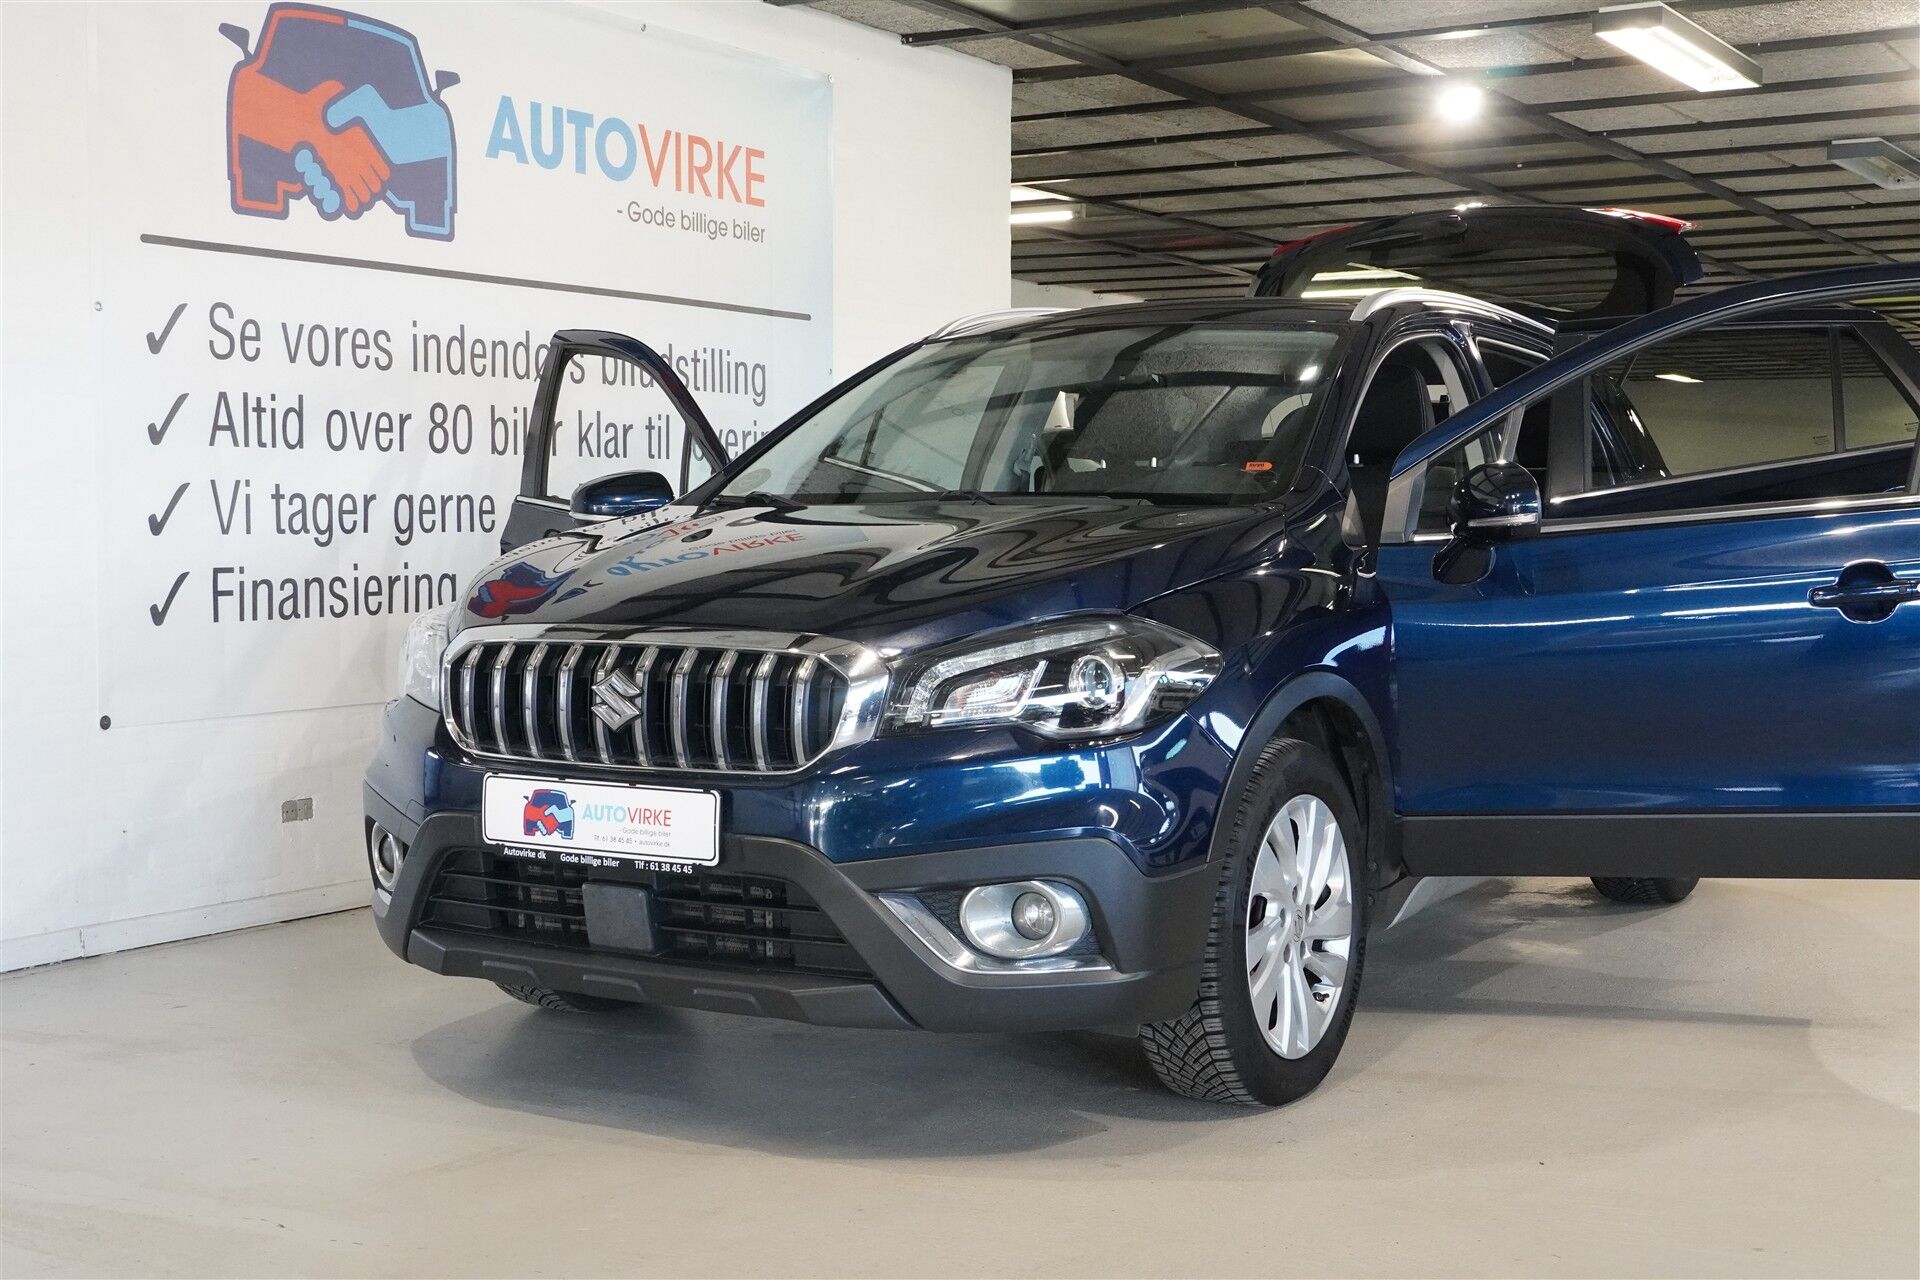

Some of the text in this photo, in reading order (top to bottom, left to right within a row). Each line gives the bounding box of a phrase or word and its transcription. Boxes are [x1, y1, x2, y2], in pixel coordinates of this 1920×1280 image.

[485, 95, 765, 207] AUTOVIRKE
[627, 200, 676, 228] Gode
[680, 210, 728, 240] billige
[733, 219, 766, 243] biler
[208, 301, 262, 362] Se
[281, 321, 394, 371] vores
[412, 320, 585, 385] indendøs
[208, 391, 304, 450] Altid
[325, 408, 412, 452] over
[428, 402, 473, 455] 80
[490, 404, 563, 457] bilr
[578, 409, 634, 459] klar
[645, 413, 671, 460] til
[210, 479, 496, 547] Vi tager gerne
[582, 804, 672, 827] AUTOVIRKE
[503, 846, 536, 859] Autovirke
[560, 853, 579, 864] Gode
[580, 854, 602, 867] billige
[603, 857, 620, 868] biler
[649, 861, 660, 871] 61
[661, 862, 671, 872] 38
[672, 863, 682, 873] 45
[683, 864, 693, 874] 45
